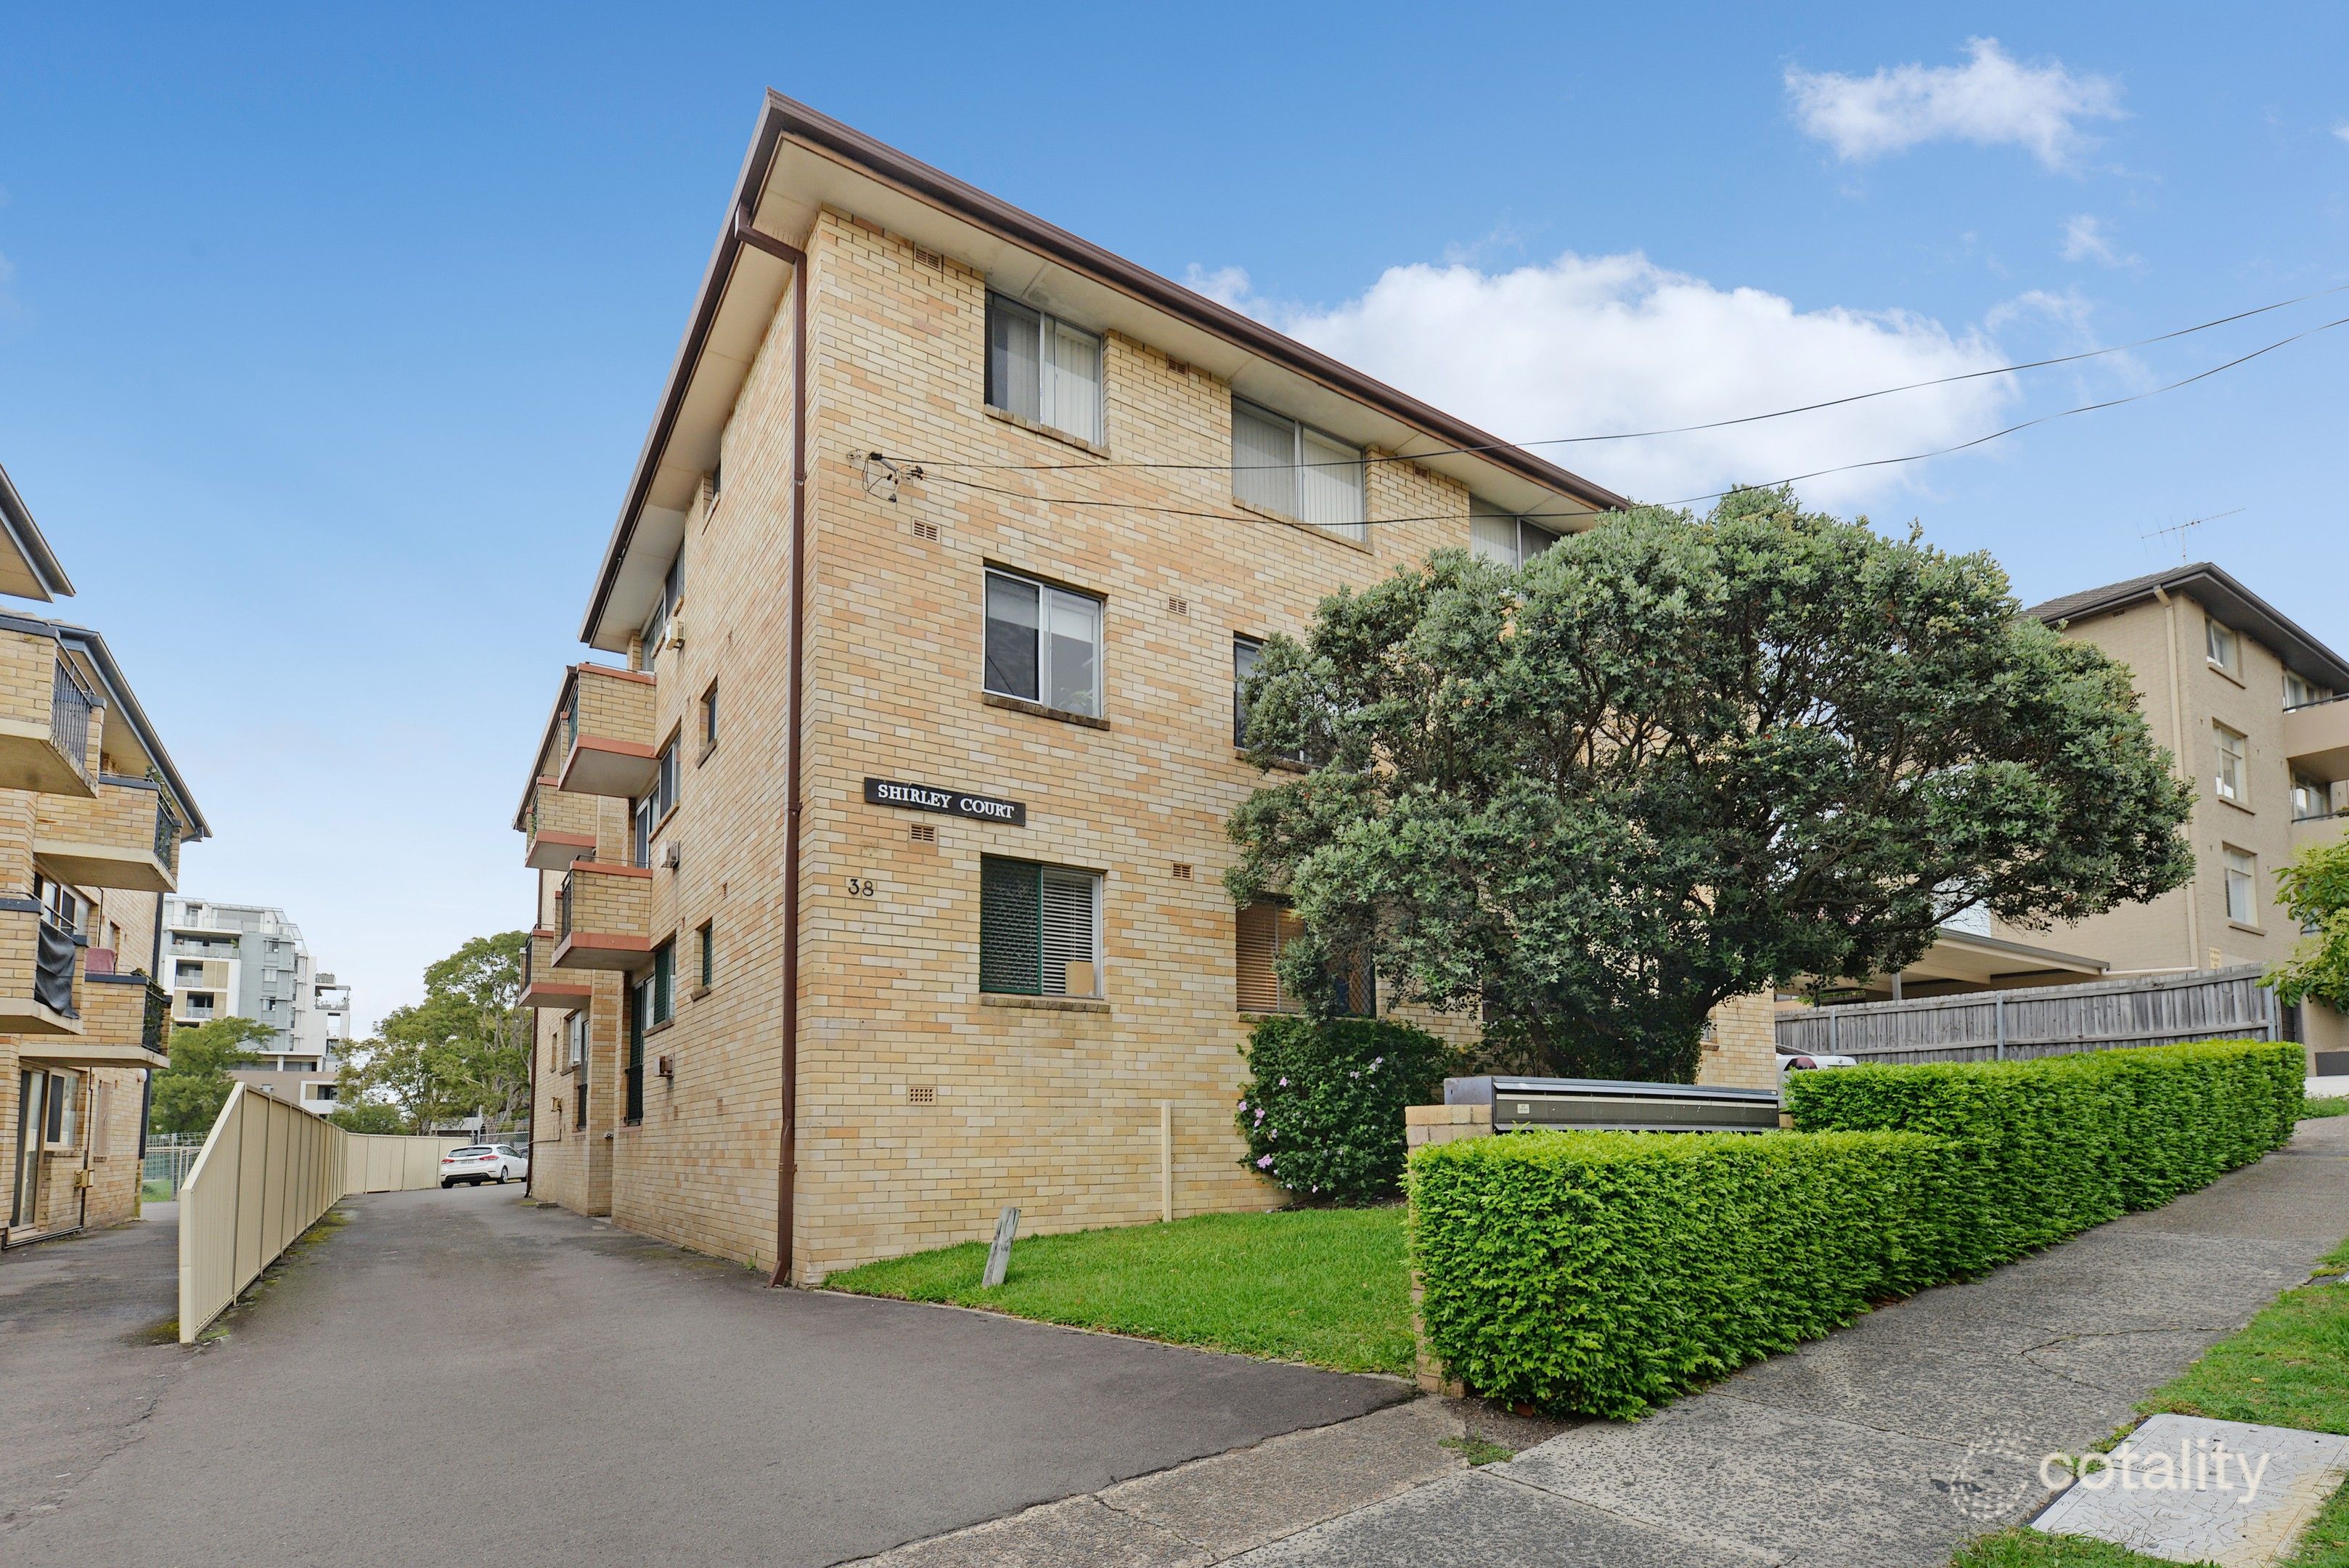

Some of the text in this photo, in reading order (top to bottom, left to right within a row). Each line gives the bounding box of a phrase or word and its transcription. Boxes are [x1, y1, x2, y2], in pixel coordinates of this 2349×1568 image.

[878, 784, 1015, 818] SHIRLEY COURT
[848, 878, 874, 897] 38
